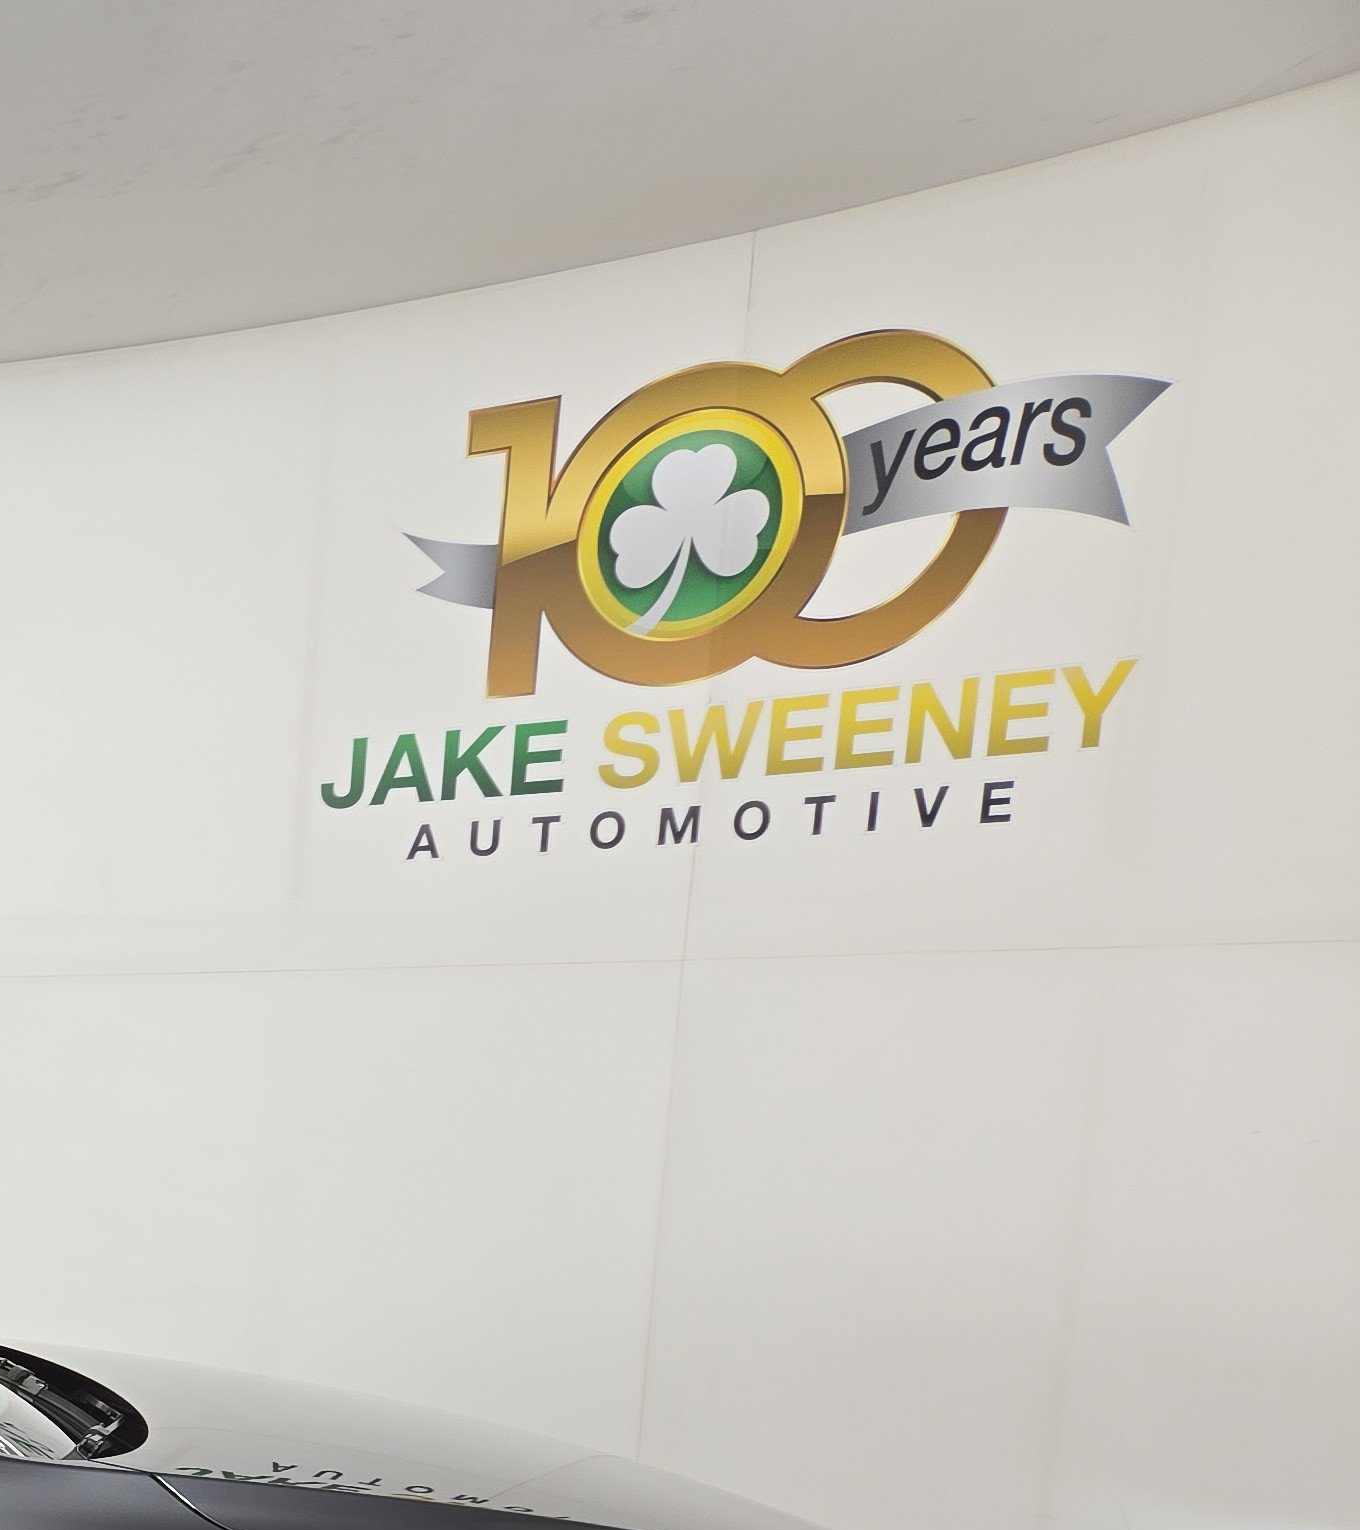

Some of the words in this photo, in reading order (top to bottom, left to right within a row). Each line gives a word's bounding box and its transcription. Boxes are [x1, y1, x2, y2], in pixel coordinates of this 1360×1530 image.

[467, 328, 1010, 699] 100
[861, 395, 1091, 517] years
[321, 719, 568, 809] JAKE
[597, 660, 1138, 790] SWEENEY
[406, 780, 1016, 861] AUTOMOTIVE
